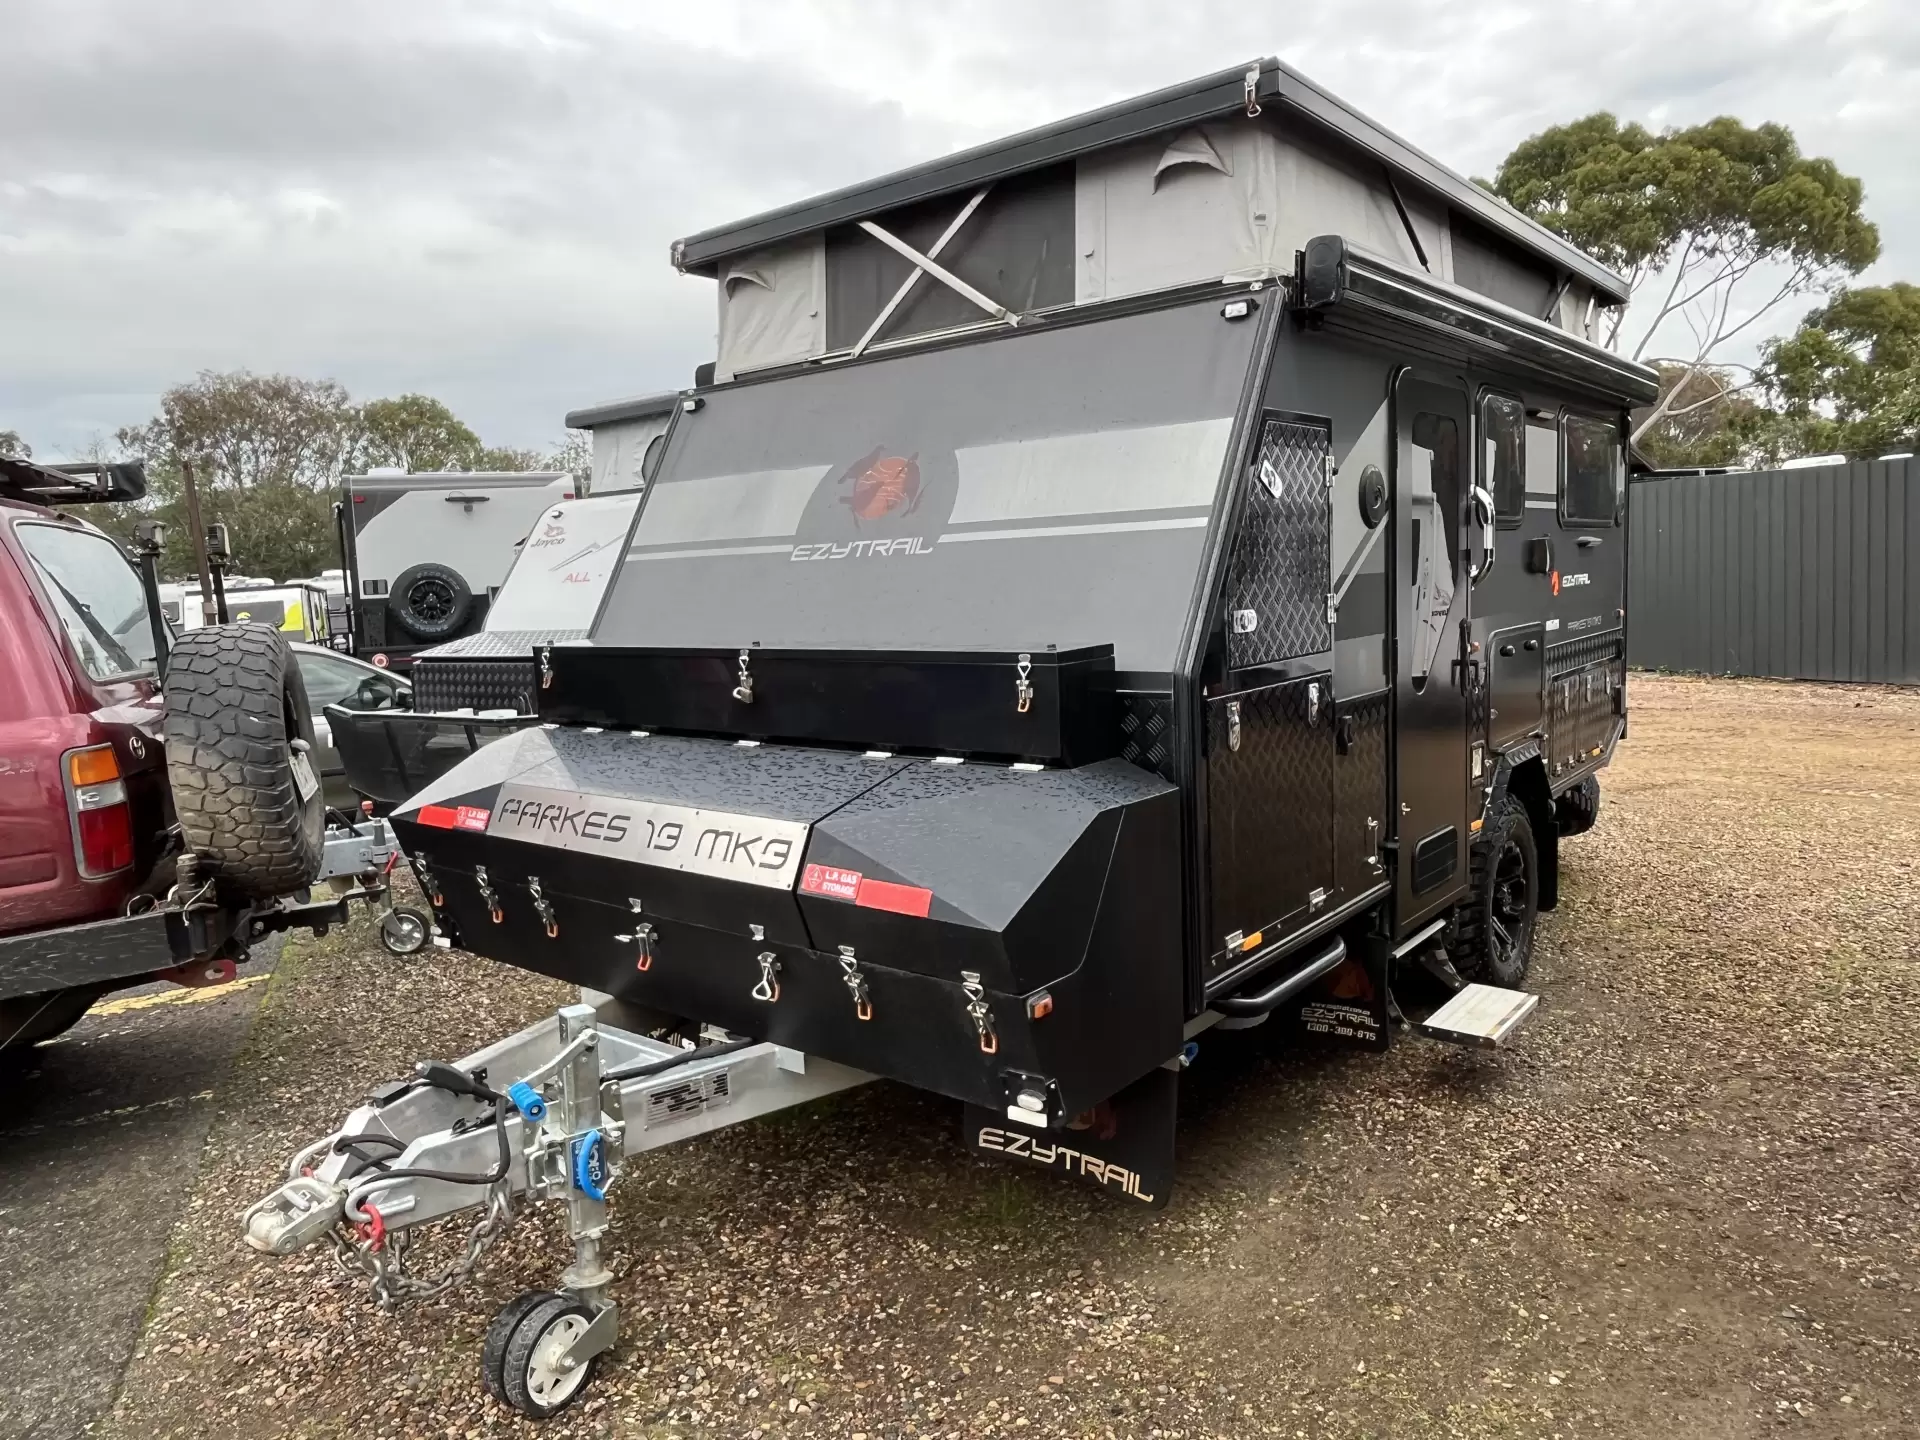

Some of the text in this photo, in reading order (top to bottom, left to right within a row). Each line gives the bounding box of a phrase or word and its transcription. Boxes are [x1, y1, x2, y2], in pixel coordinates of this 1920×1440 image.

[790, 536, 933, 561] EZYTRAIL
[562, 572, 591, 583] ALL
[498, 798, 632, 843] PARKES
[840, 873, 858, 885] GAS
[1301, 1007, 1380, 1028] EZYTRAIL
[978, 1127, 1154, 1203] EZYTRAIL
